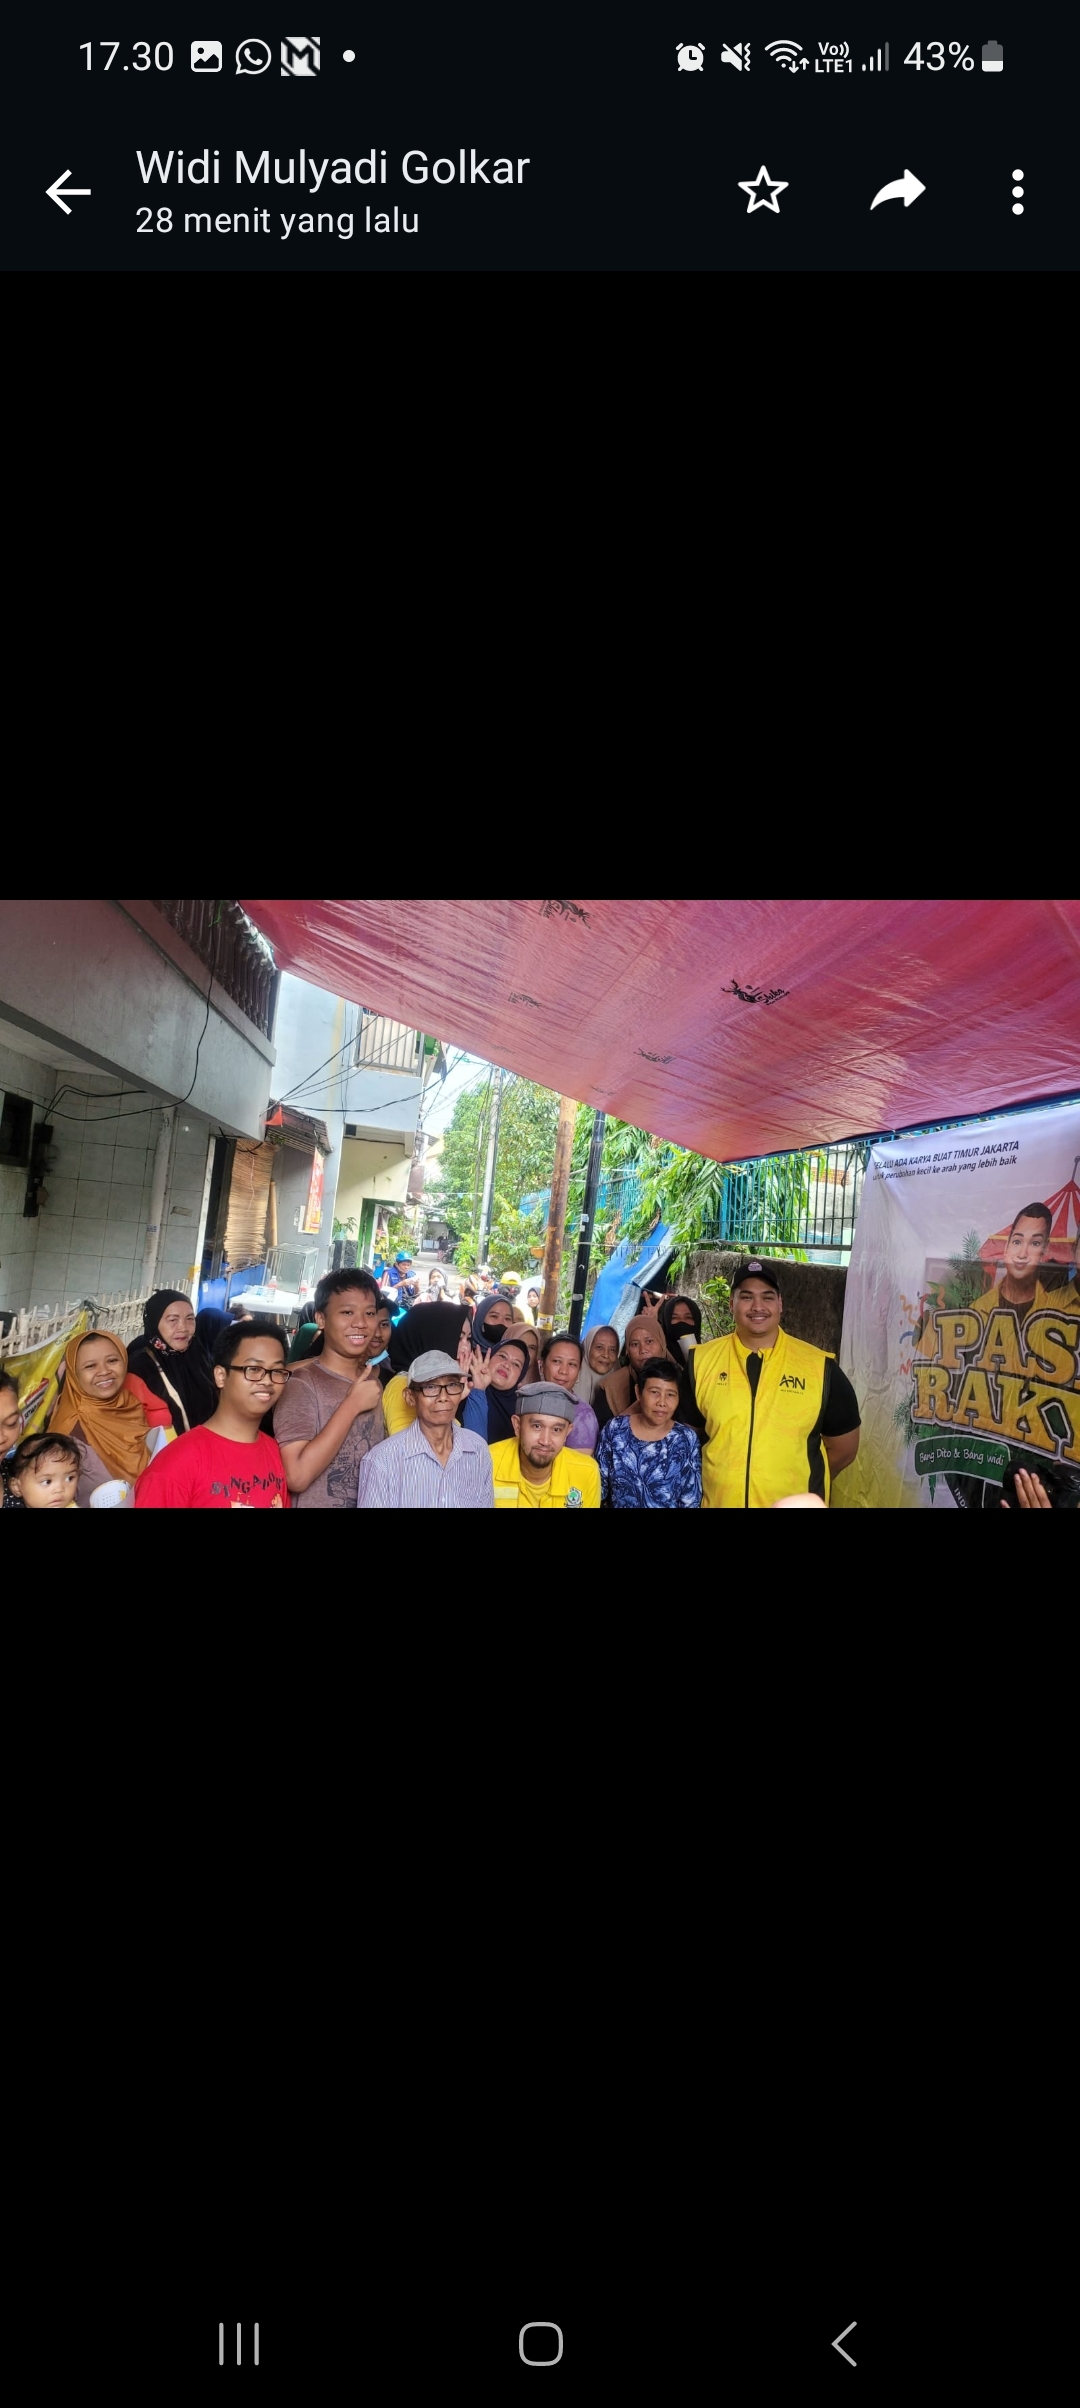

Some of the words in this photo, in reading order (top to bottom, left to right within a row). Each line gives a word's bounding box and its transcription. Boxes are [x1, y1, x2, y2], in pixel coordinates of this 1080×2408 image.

[80, 42, 173, 71] 17.30
[815, 59, 852, 73] LTE1
[904, 42, 974, 71] 43%
[136, 149, 219, 184] Widi
[236, 149, 386, 193] Mulyadi
[402, 149, 530, 184] Golkar
[136, 207, 173, 233] 28
[184, 207, 270, 233] menit
[280, 213, 353, 240] yang
[366, 206, 418, 233] lalu
[894, 1158, 907, 1168] ADA
[908, 1155, 931, 1165] KARYA
[933, 1151, 952, 1162] BUAT
[954, 1147, 980, 1159] TIMUR
[980, 1140, 1019, 1156] JAKARTA
[917, 1165, 931, 1176] kecil
[932, 1164, 941, 1174] ke
[941, 1162, 957, 1173] arah
[957, 1161, 976, 1174] yang
[978, 1157, 997, 1169] lebih
[999, 1155, 1018, 1166] baik
[934, 1309, 1080, 1388] PAS
[919, 1451, 935, 1463] Bang
[936, 1447, 951, 1458] Dito
[953, 1448, 961, 1459] &
[963, 1448, 984, 1464] Bang
[986, 1452, 1005, 1466] widi
[954, 1487, 968, 1508] IND
